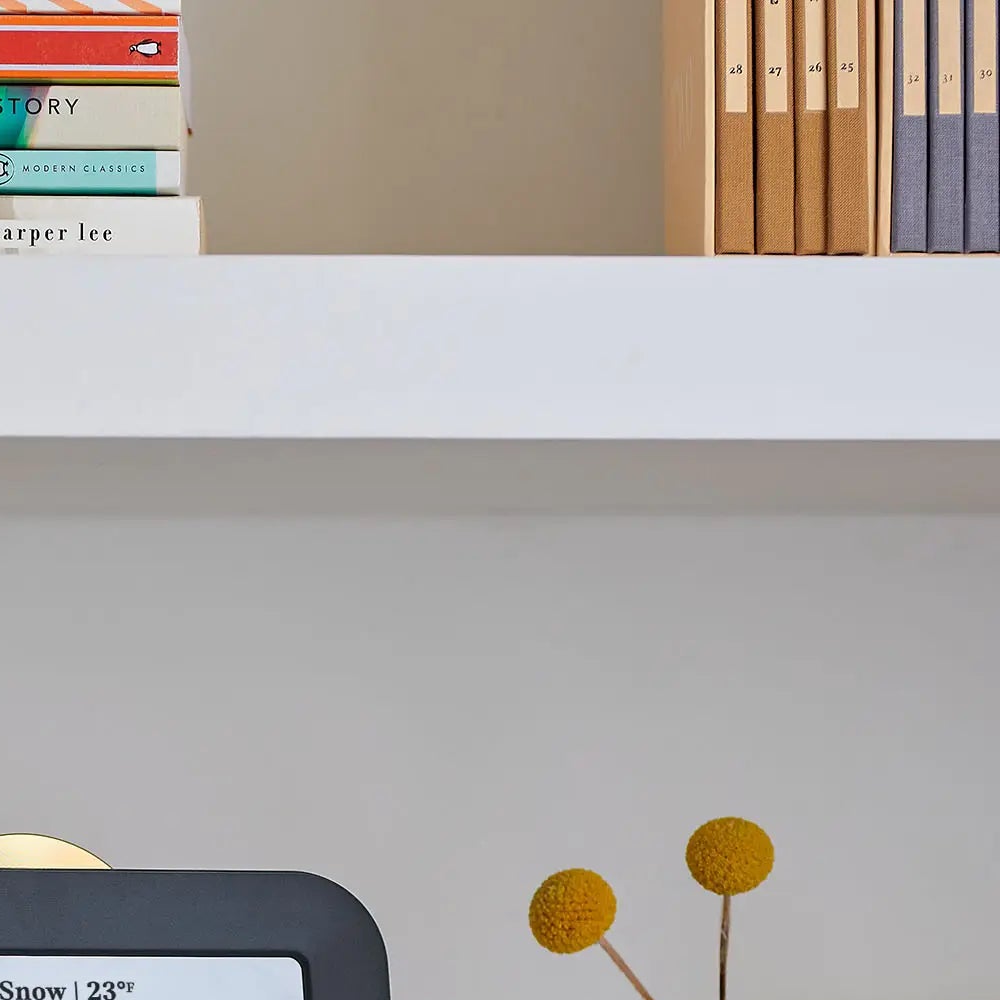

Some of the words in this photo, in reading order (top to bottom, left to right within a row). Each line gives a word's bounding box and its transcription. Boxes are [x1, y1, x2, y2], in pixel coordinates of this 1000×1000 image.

[730, 64, 742, 74] 28
[769, 67, 781, 76] 27
[809, 62, 822, 72] 26
[841, 63, 853, 72] 25
[943, 74, 952, 83] 31
[981, 70, 992, 79] 30
[908, 75, 919, 84] 32
[79, 223, 111, 241] lee
[0, 981, 66, 1000] Snow
